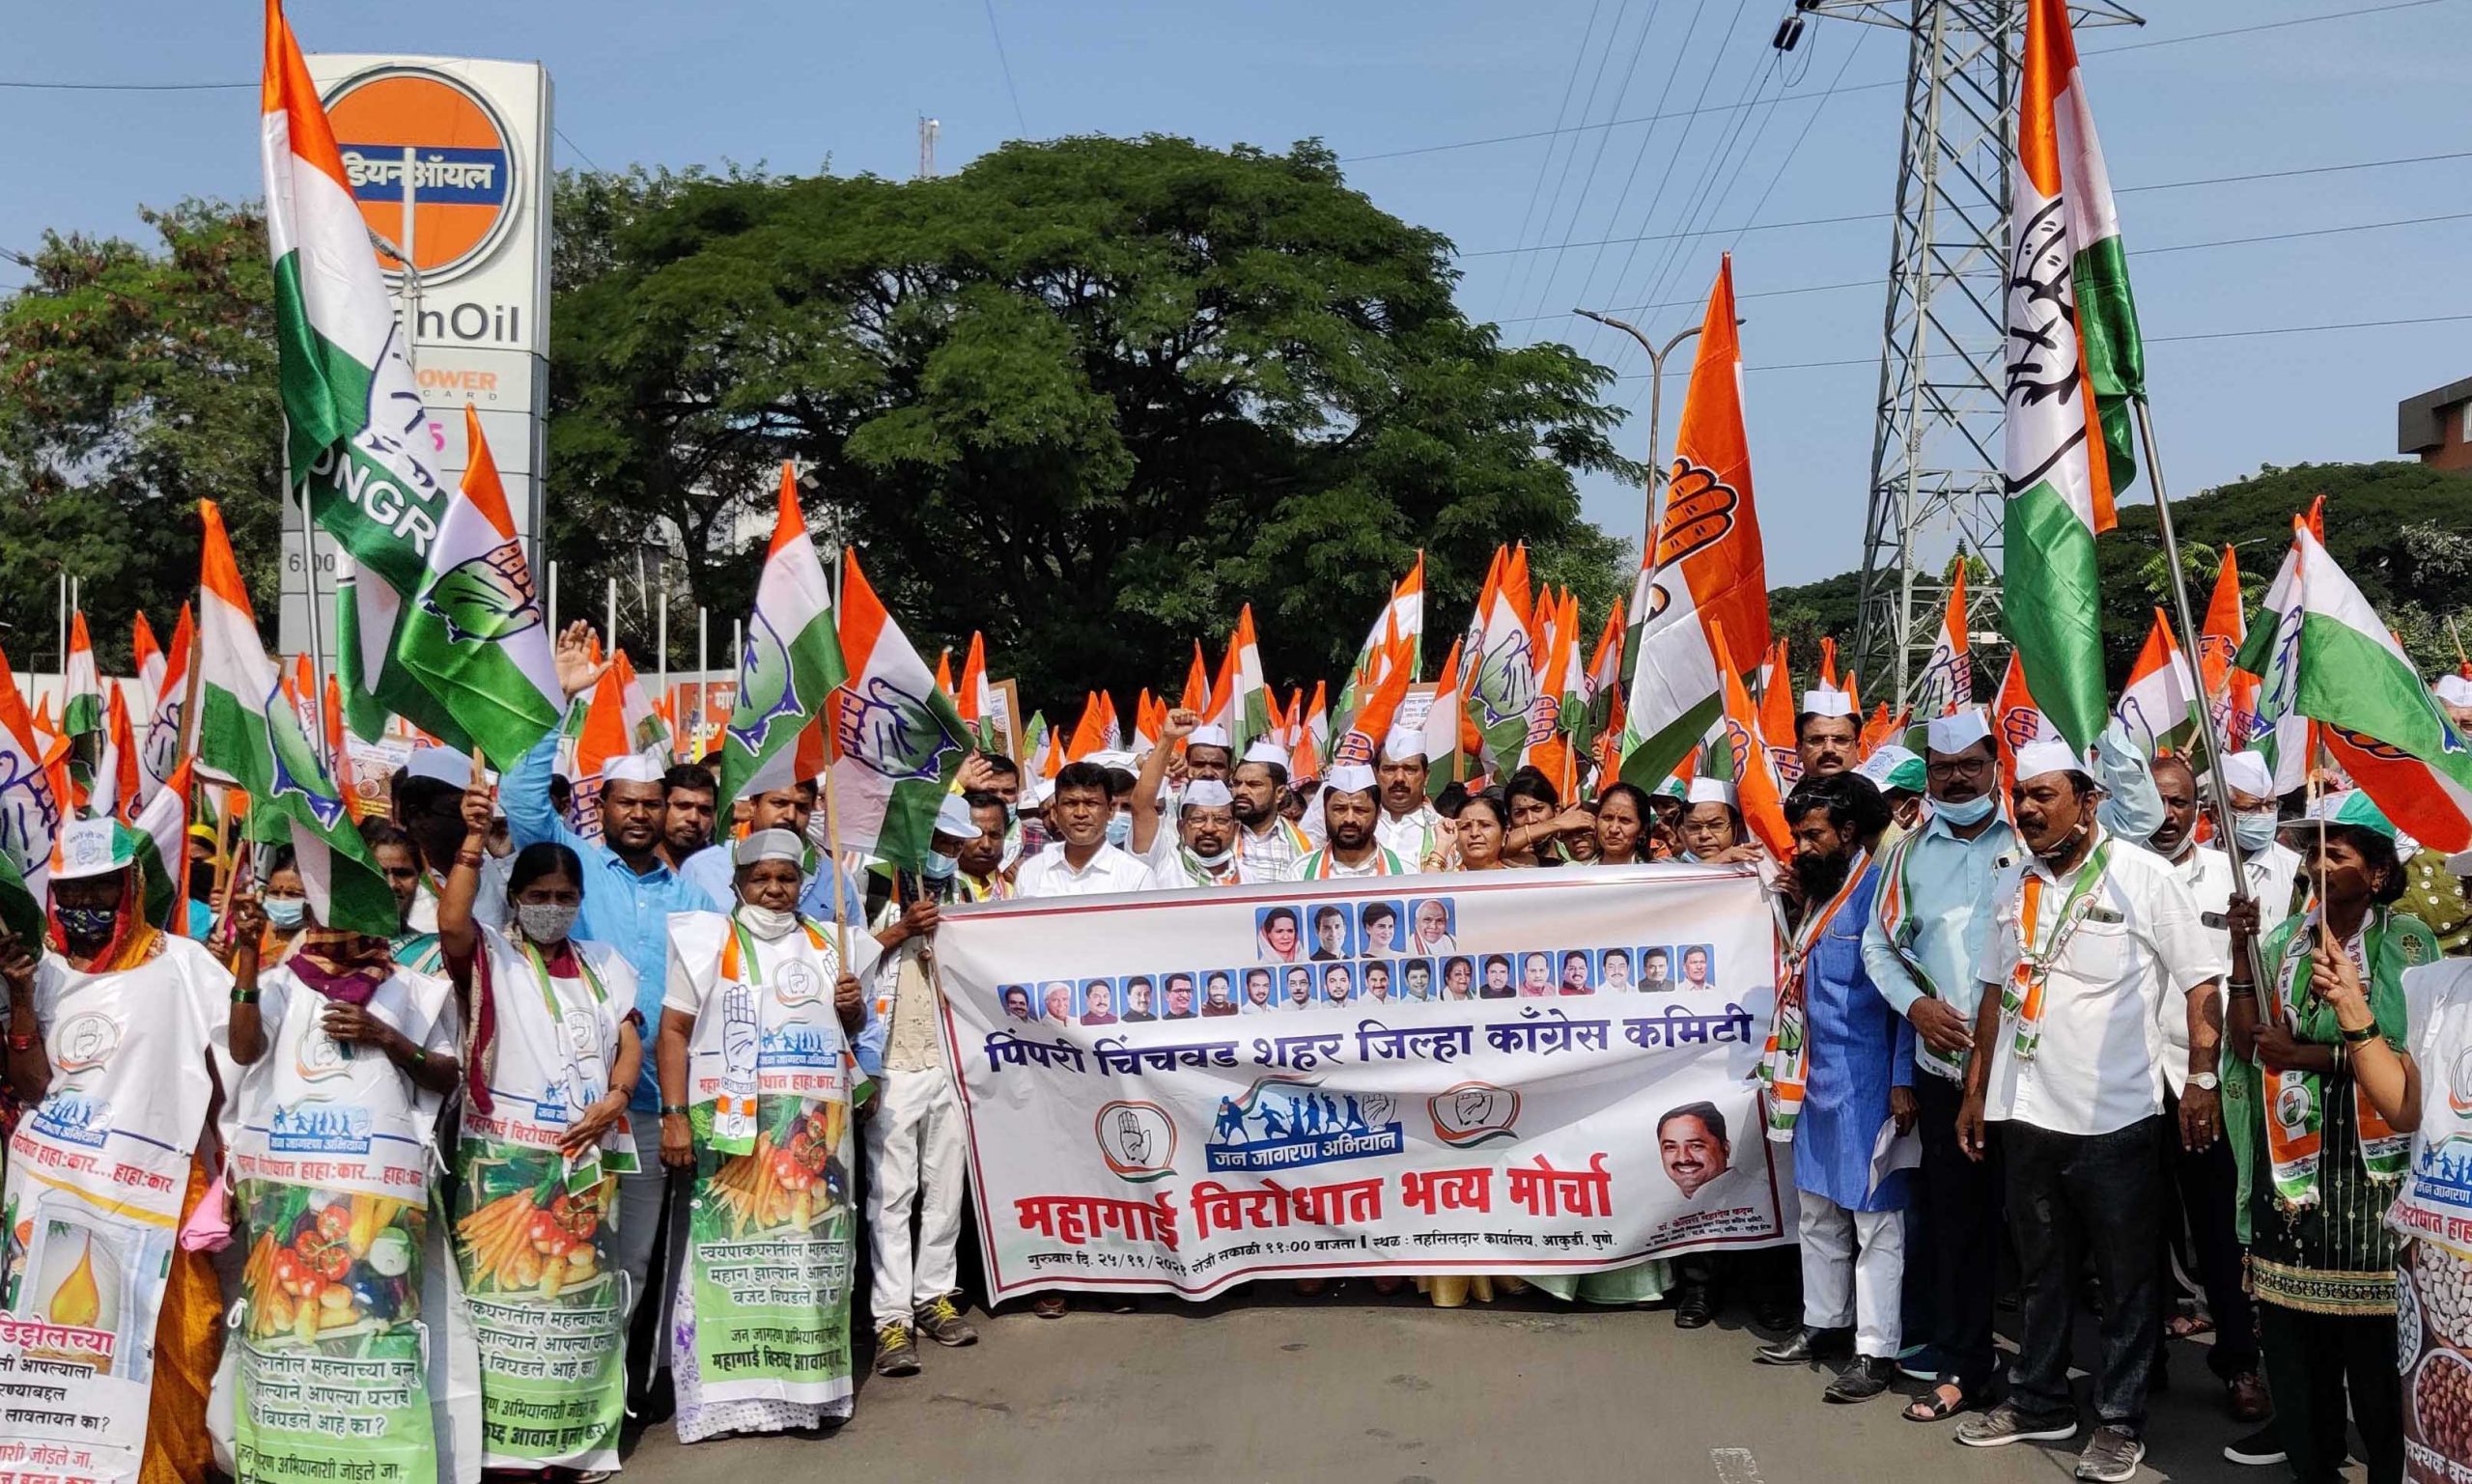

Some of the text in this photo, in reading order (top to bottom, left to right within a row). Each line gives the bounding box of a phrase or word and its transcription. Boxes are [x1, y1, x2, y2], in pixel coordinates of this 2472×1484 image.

[416, 369, 497, 390] OWER
[984, 1028, 1085, 1073] पिंपरी
[1093, 1034, 1239, 1076] चिंचवड
[1253, 1034, 1344, 1071] शहर
[1355, 1019, 1474, 1063] जिल्हा
[1623, 1003, 1754, 1049] कमिटी
[1214, 1131, 1396, 1166] जन जागरण अभियान
[1014, 1153, 1613, 1251] महागाई विरोधात भव्य मोर्चा
[1314, 1238, 1355, 1250] वाजता
[1413, 1230, 1479, 1247] तहसिलदार
[713, 1344, 760, 1370] महागाई
